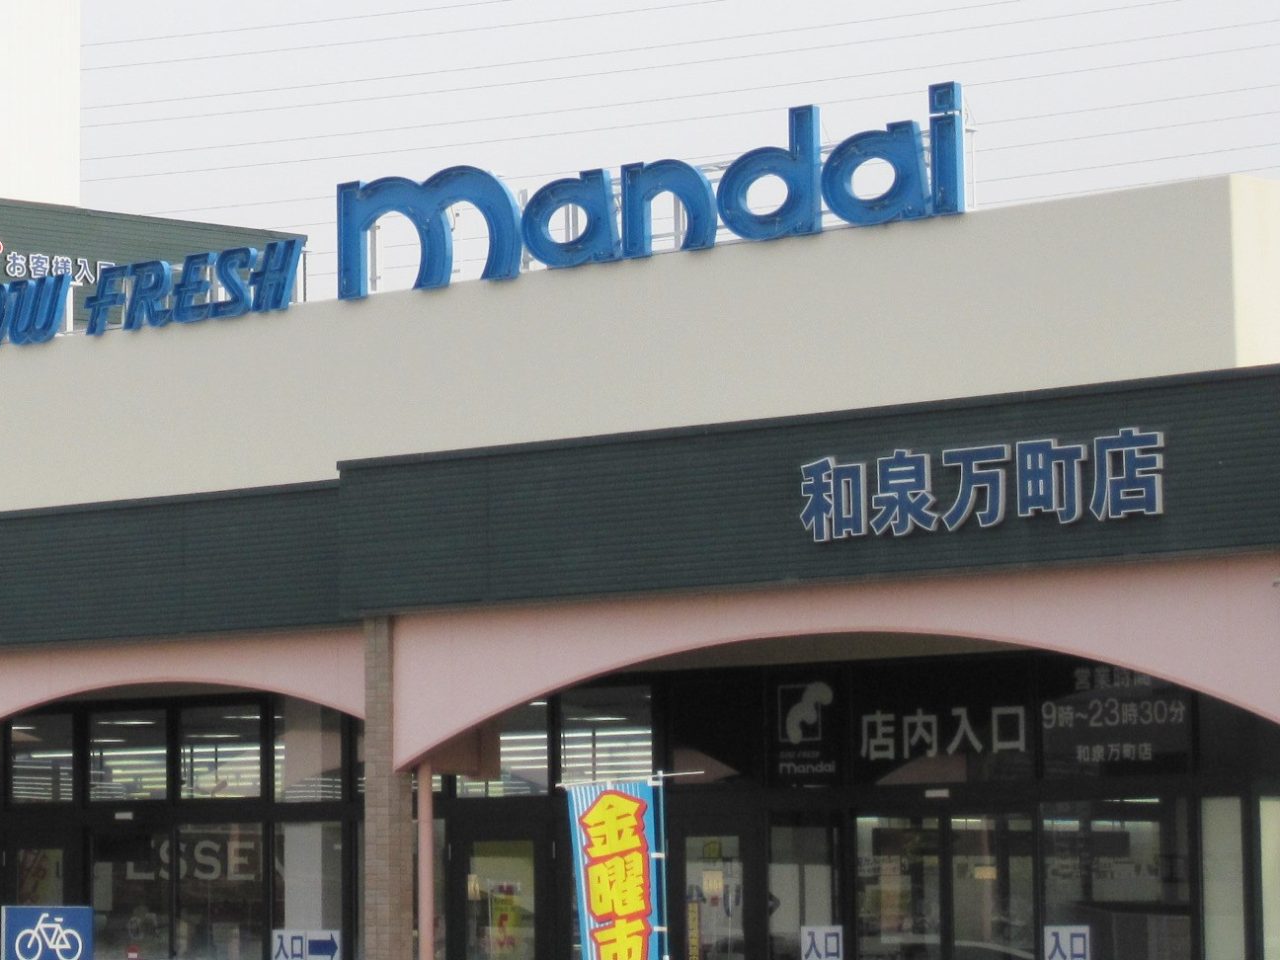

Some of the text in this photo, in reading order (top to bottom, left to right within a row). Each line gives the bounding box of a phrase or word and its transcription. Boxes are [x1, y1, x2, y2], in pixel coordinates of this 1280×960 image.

[337, 81, 966, 300] mandai
[84, 238, 306, 336] FRESH
[799, 427, 1165, 542] 和泉万町店
[860, 705, 1026, 761] 店内入口
[779, 760, 836, 775] mandai
[1076, 742, 1153, 763] 和泉万町店
[274, 934, 304, 960] 入口
[804, 930, 840, 960] 入口
[1048, 931, 1087, 960] 入口
